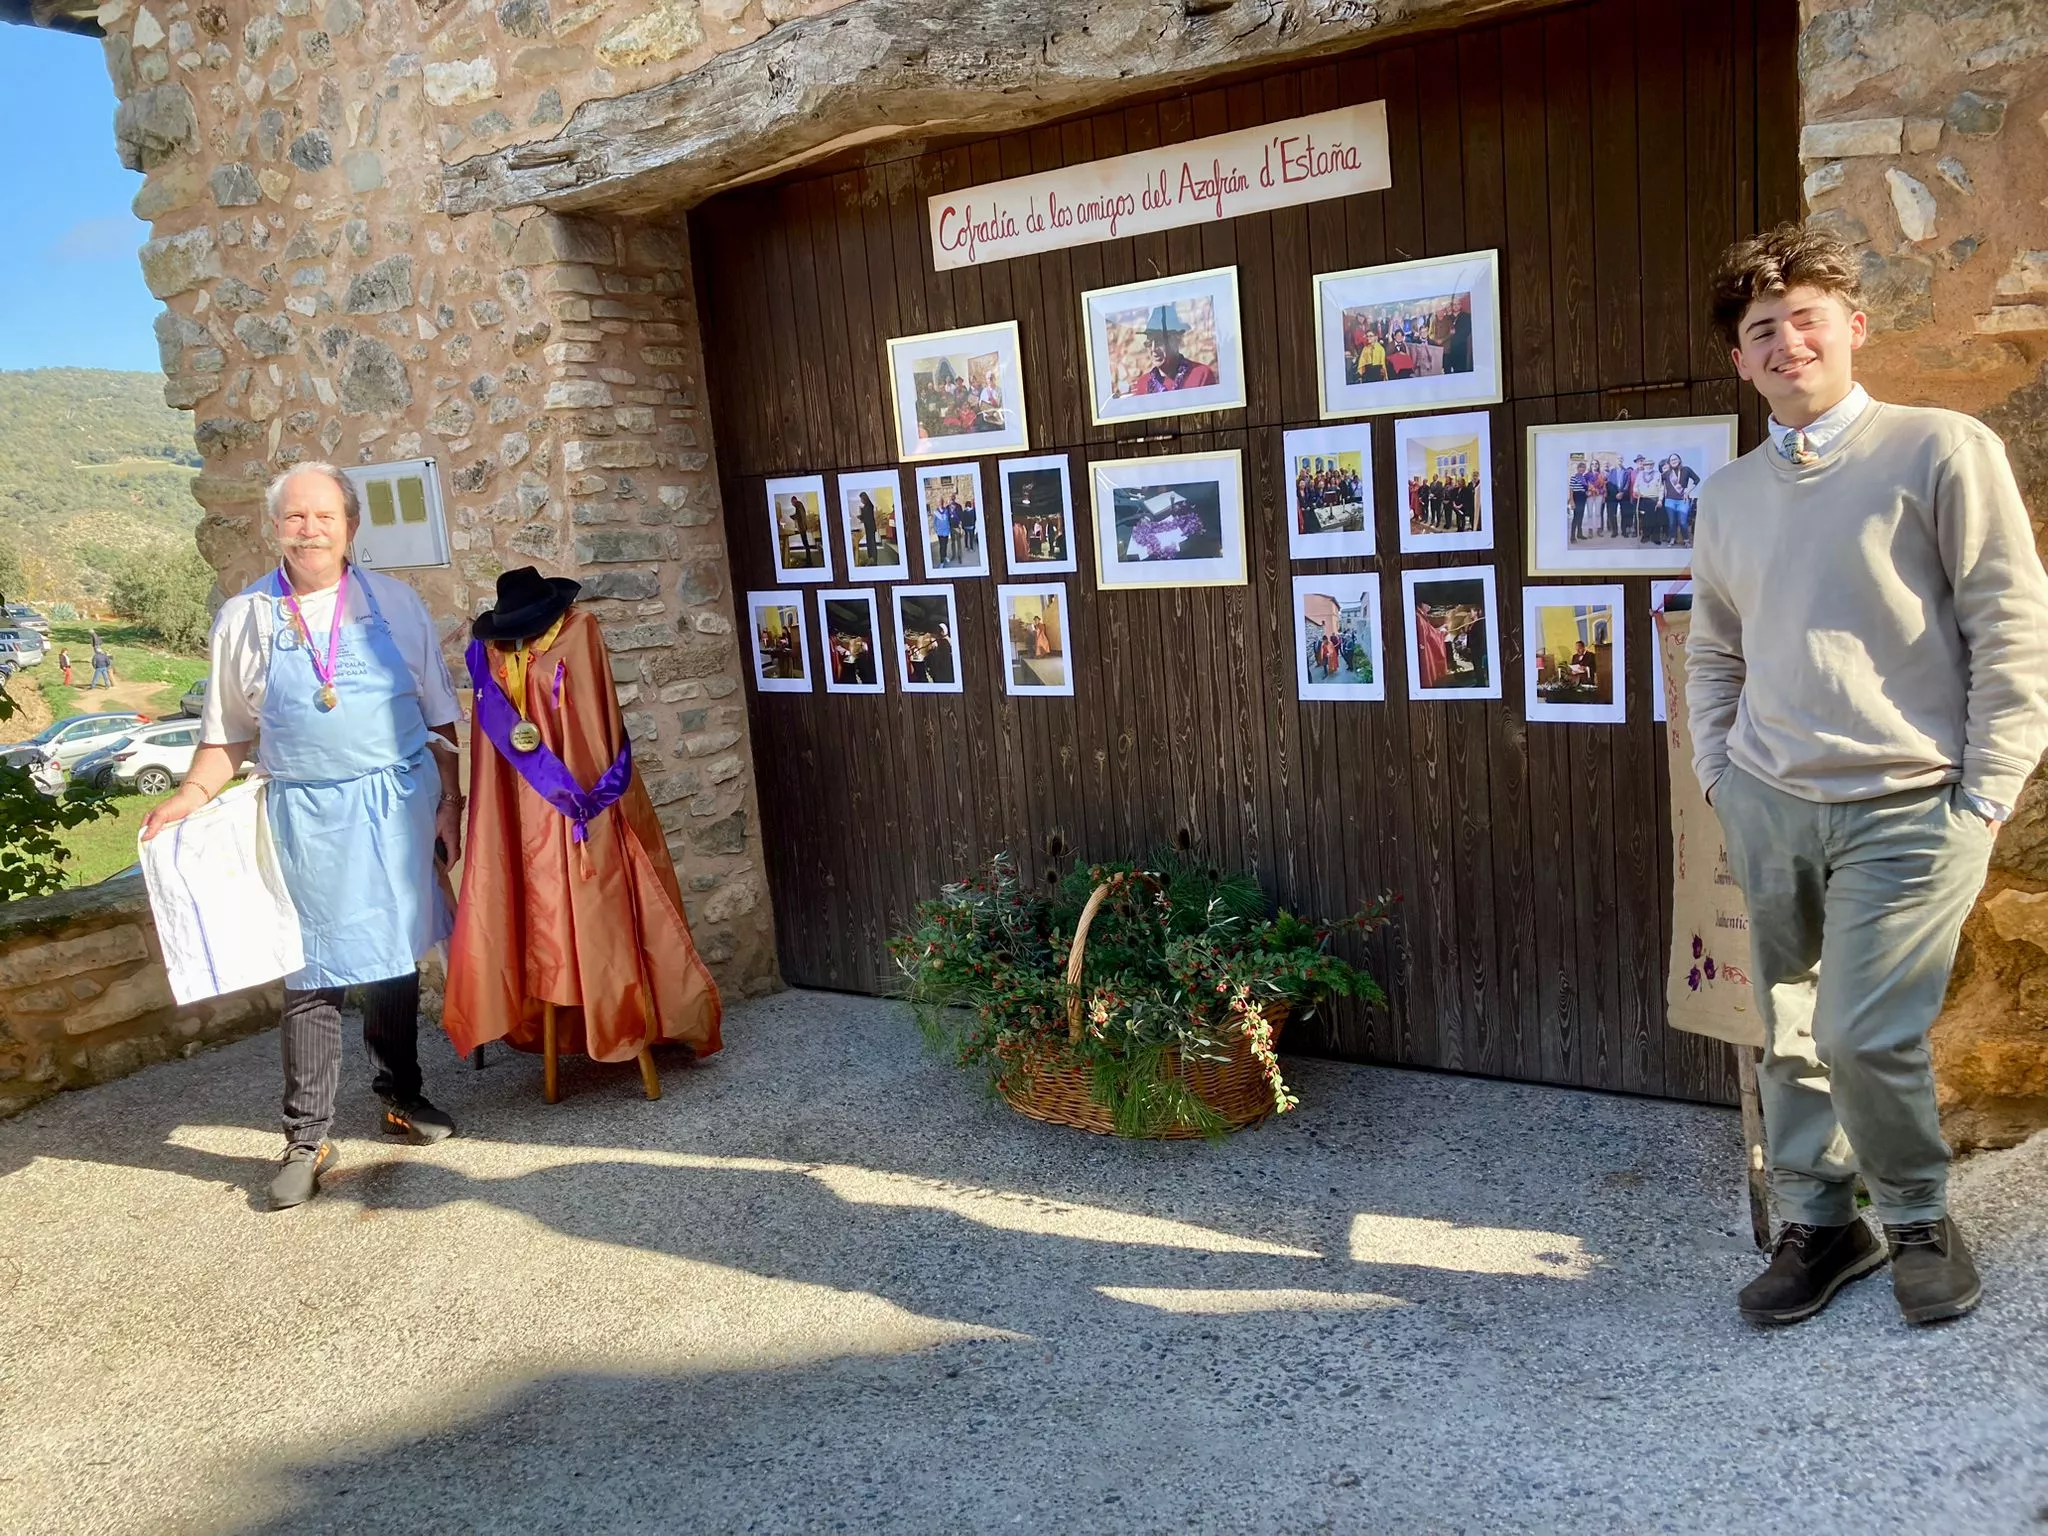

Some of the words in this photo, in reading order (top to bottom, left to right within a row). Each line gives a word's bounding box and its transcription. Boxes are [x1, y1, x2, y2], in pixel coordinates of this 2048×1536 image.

[938, 201, 1020, 263] Cofradía
[1026, 195, 1046, 234] de
[1050, 191, 1073, 229] los
[1076, 193, 1136, 237] amigos
[1141, 168, 1172, 212] del
[1178, 158, 1250, 218] Azafrán
[1259, 133, 1363, 189] d'Estaña
